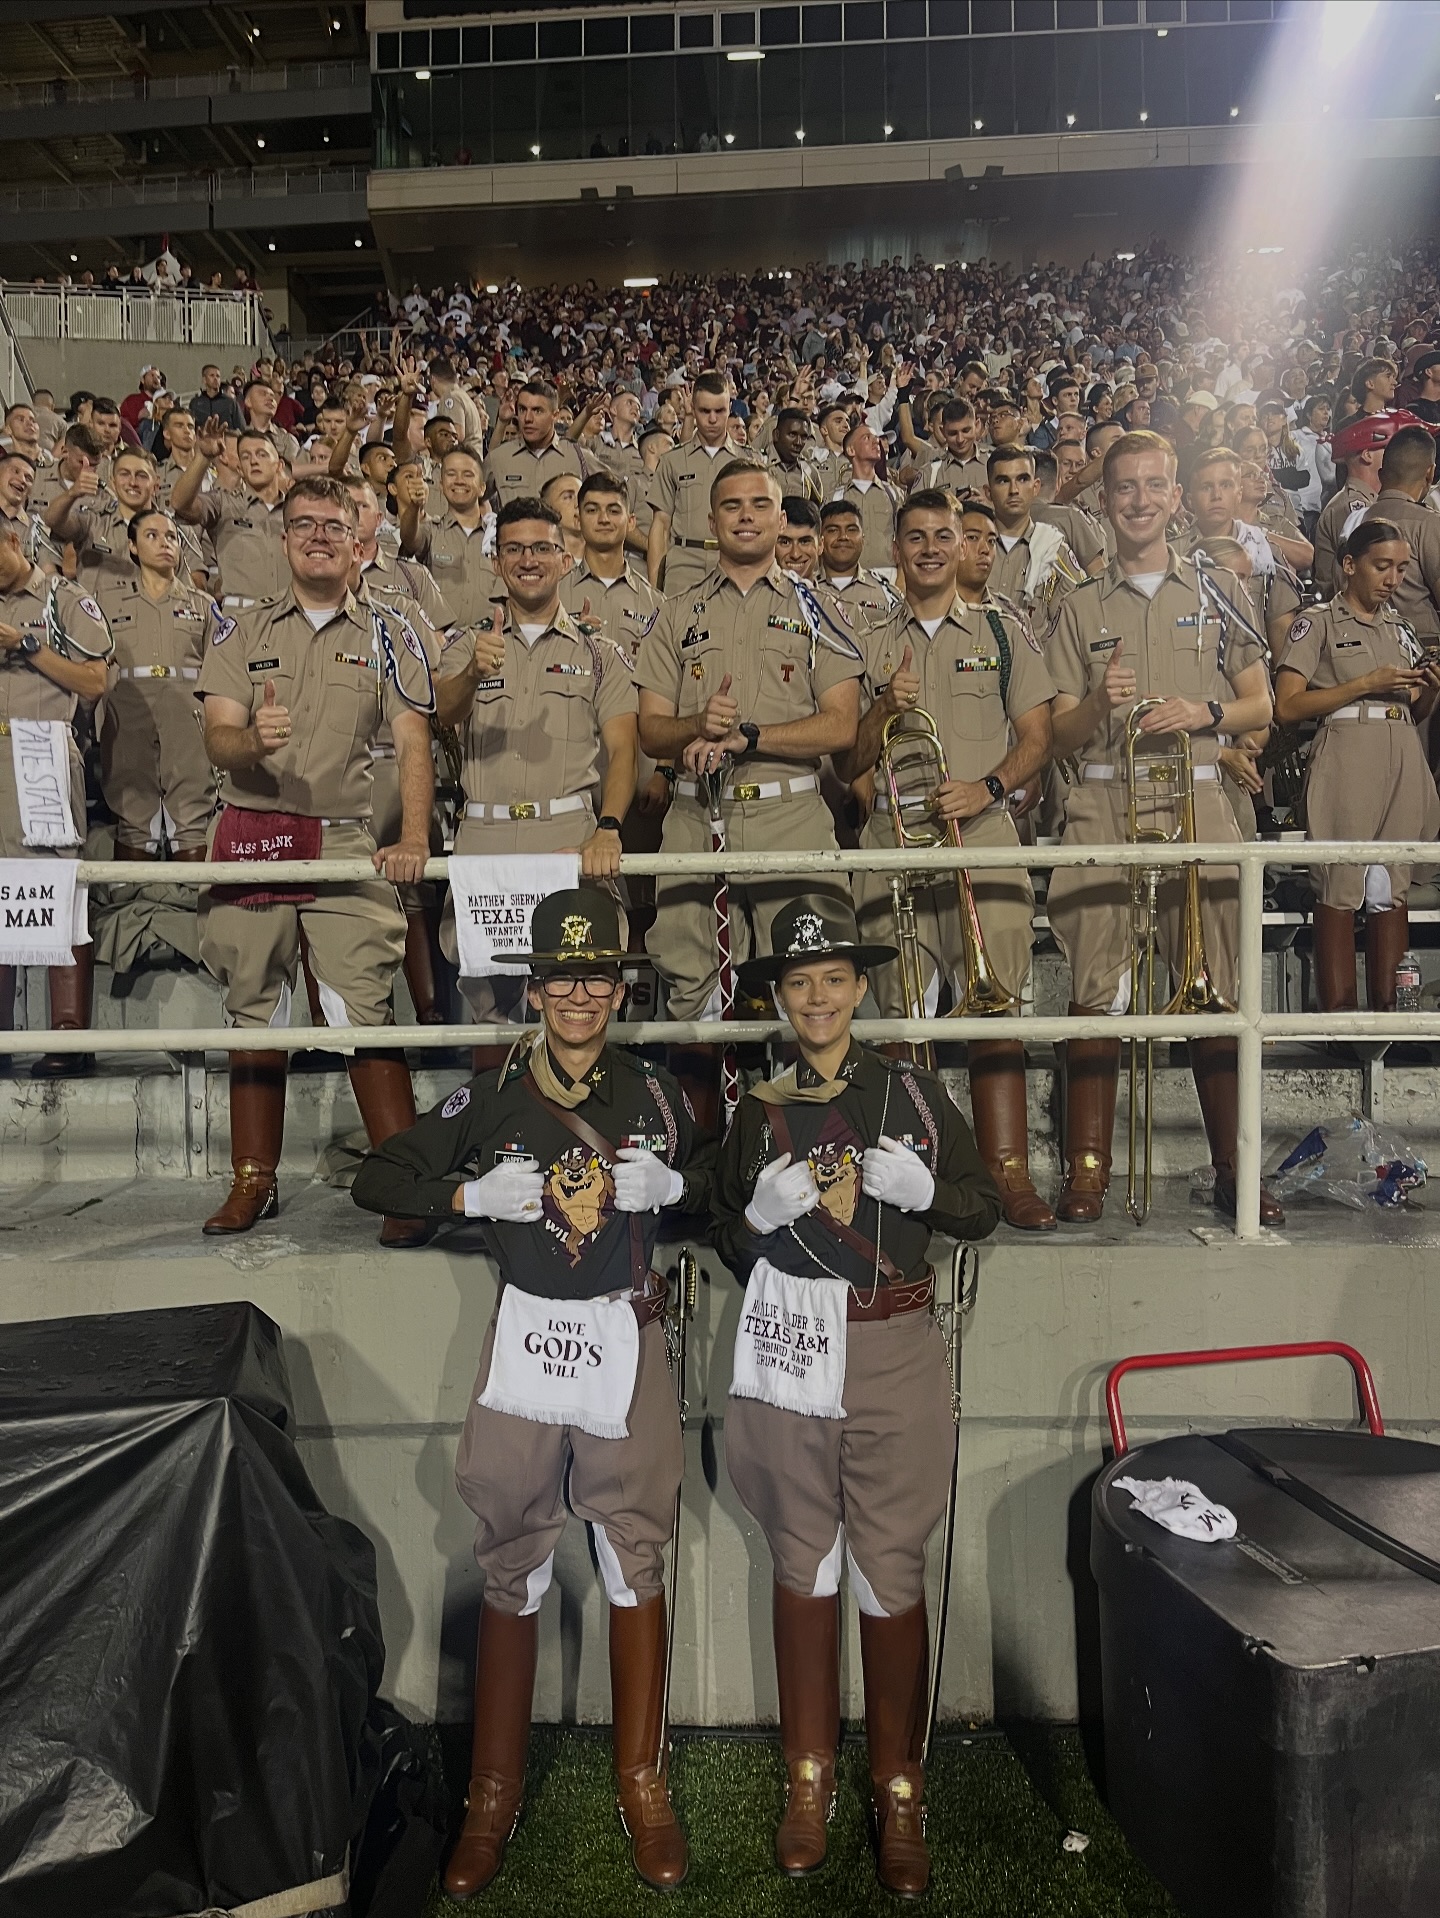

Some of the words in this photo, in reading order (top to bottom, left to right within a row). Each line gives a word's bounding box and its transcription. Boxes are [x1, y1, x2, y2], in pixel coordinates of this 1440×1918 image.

[23, 772, 66, 835] STATE
[230, 840, 257, 856] BASS
[260, 835, 293, 853] RANK
[467, 894, 506, 908] MATTHEW
[4, 907, 55, 928] MAN
[470, 908, 525, 925] TEXAS
[484, 926, 524, 937] INFANTRY
[492, 937, 514, 948] DRUM
[547, 1318, 587, 1337] LOVE
[813, 1315, 825, 1333] '26
[743, 1314, 792, 1345] TEXAS
[794, 1333, 830, 1356] A&M
[523, 1331, 604, 1368] GOD'S
[756, 1353, 781, 1371] DRUM
[778, 1359, 806, 1380] MAJOR
[791, 1352, 814, 1367] BAND
[542, 1361, 579, 1379] WILL
